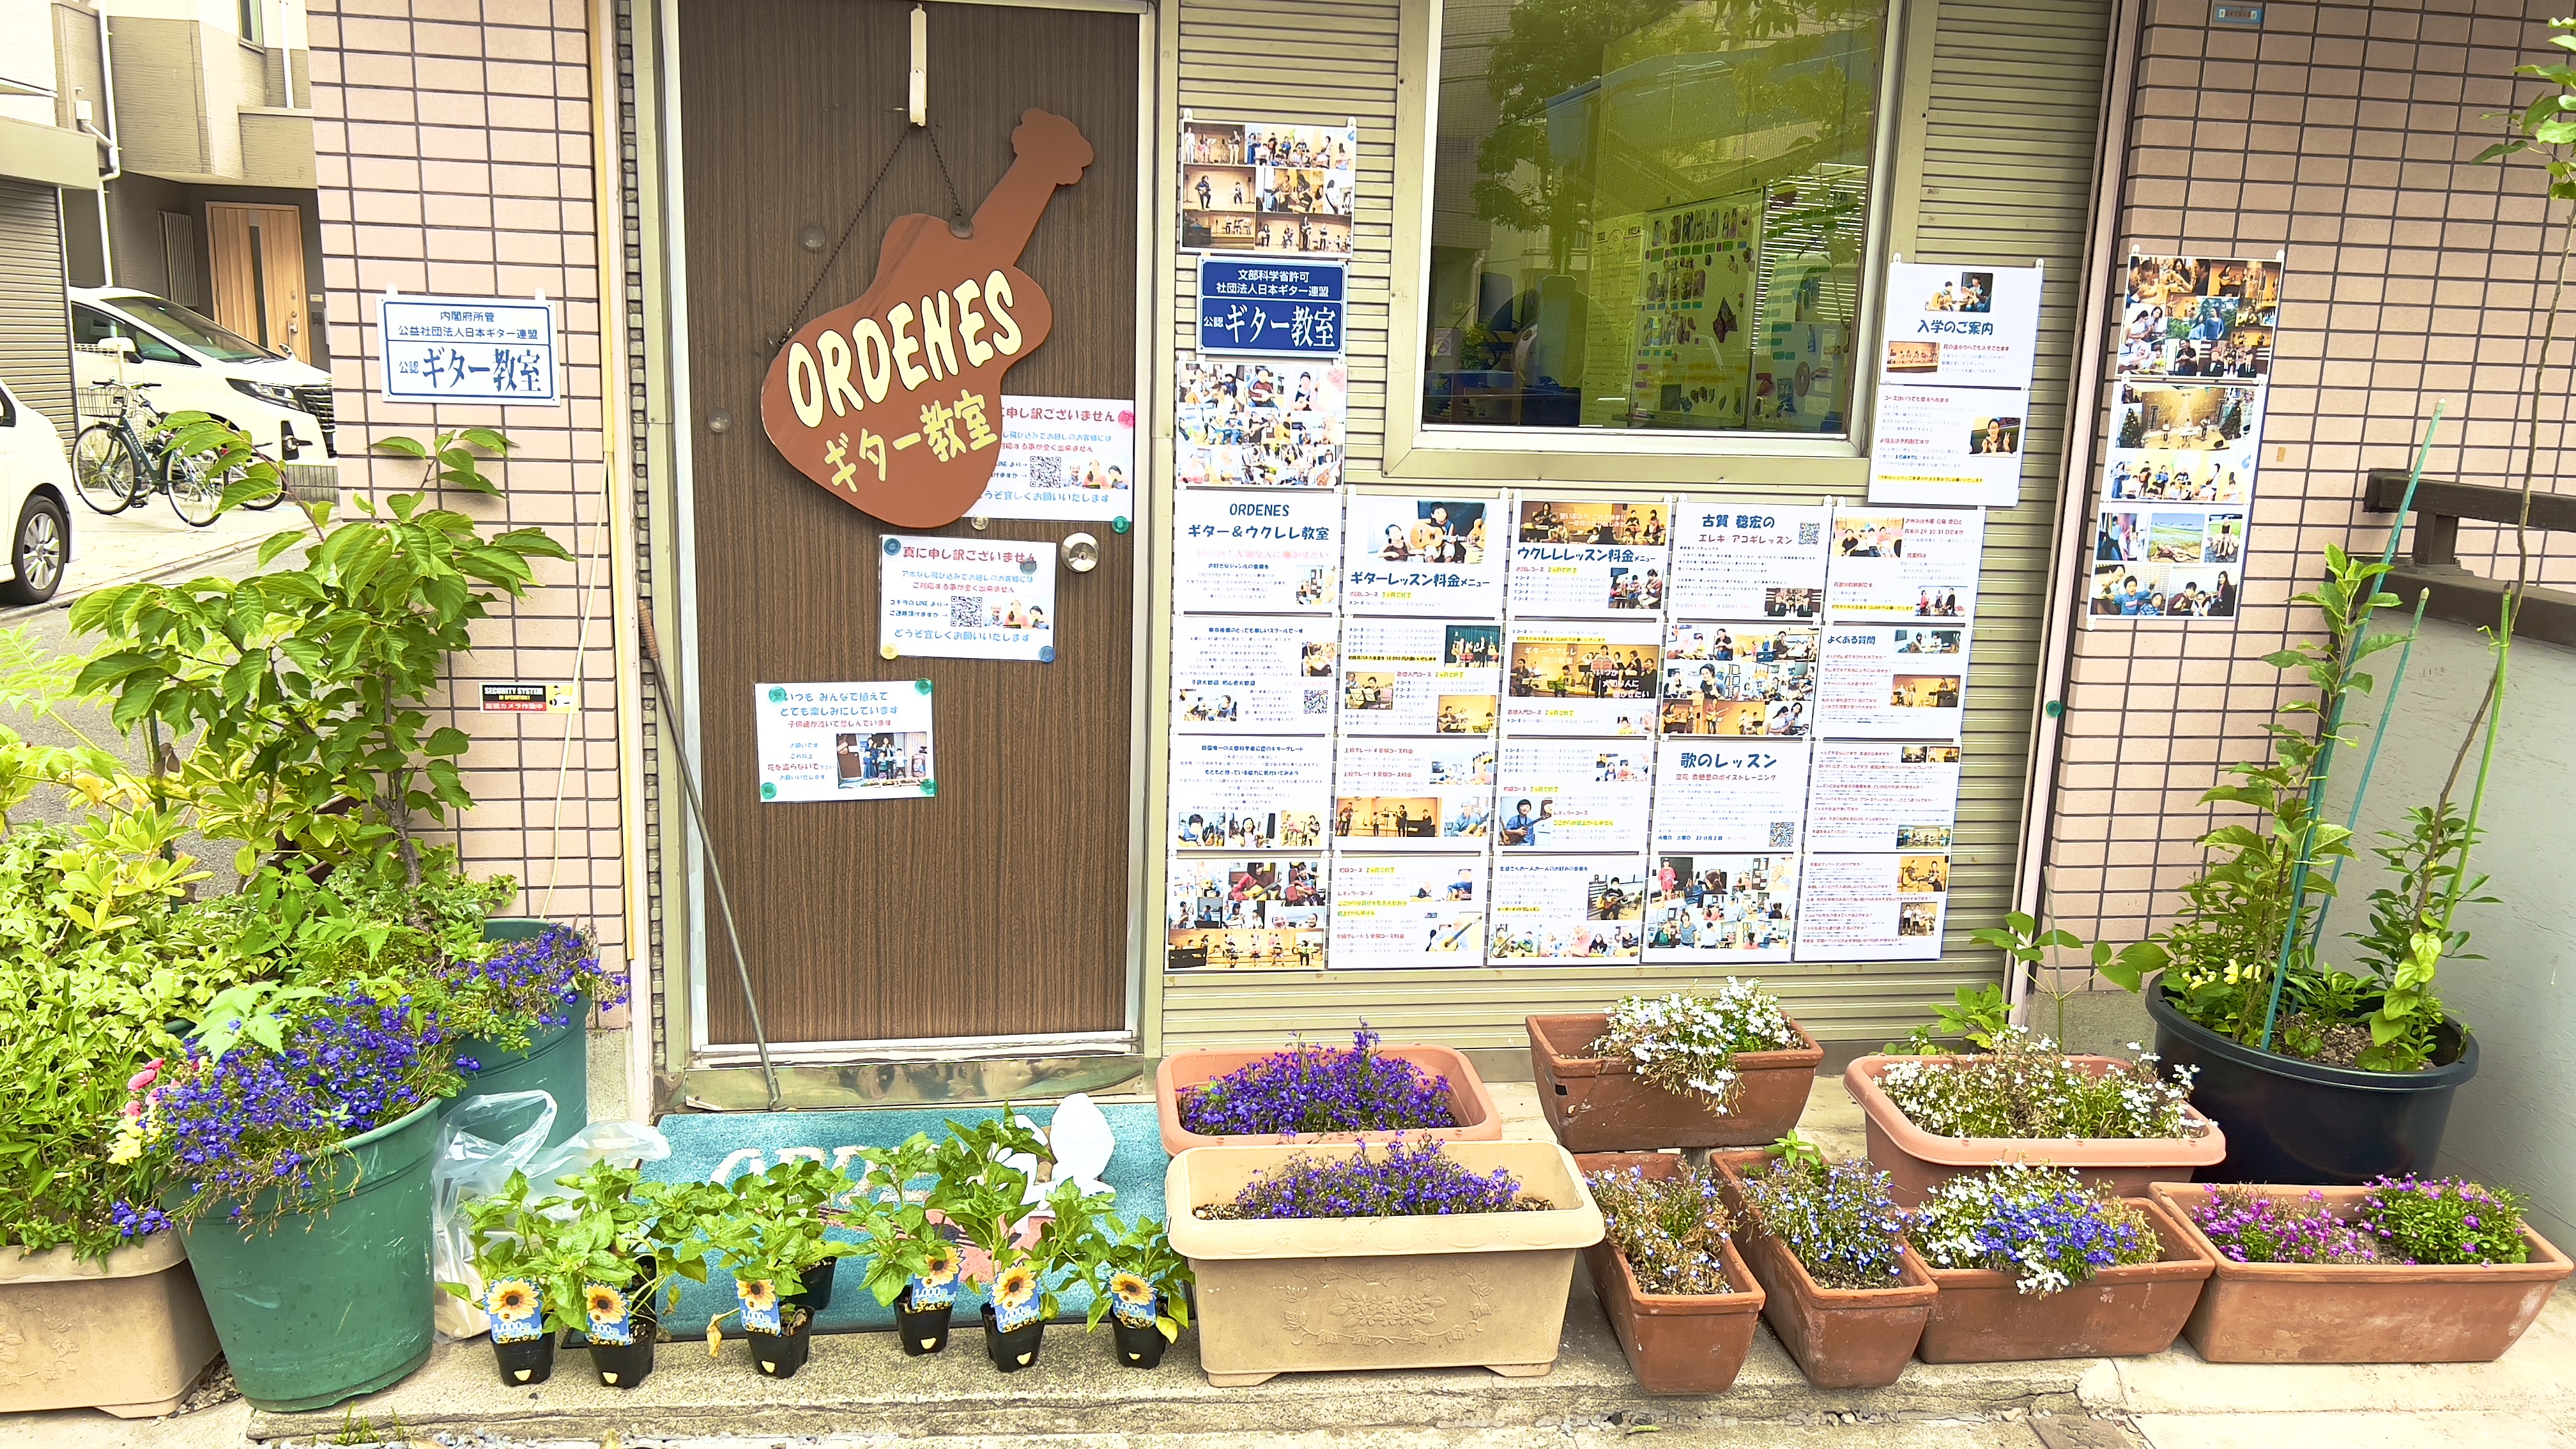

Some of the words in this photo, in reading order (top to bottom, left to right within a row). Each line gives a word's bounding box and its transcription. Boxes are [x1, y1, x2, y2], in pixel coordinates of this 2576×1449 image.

[1238, 269, 1310, 283] 文部科学省許可
[1216, 282, 1329, 297] 社団法人日本ギター連盟
[440, 311, 494, 322] 内閣府所管
[399, 325, 538, 339] 公益社団法人日本ギター連盟
[1204, 316, 1223, 328] 公認
[1225, 303, 1336, 347] ギター教室
[1917, 319, 1993, 335] 入学のご案内
[788, 269, 1023, 428] ORDENES
[399, 361, 418, 373] 公認
[422, 346, 541, 392] ギター教室
[824, 388, 998, 493] ギター教室
[979, 490, 1109, 503] うぞ宜しくお願いいたします
[1229, 503, 1290, 516] ORDENES
[1703, 514, 1729, 527] 古賀
[903, 546, 1036, 564] 真に申し訳ございません
[1517, 547, 1655, 562] ウクレレレッスン料金メニュー
[1351, 572, 1490, 587] ギターレッスン料金メニュー
[894, 629, 1030, 642] どうぞ宜しくお願いいたします
[1828, 636, 1876, 645] よくある質問
[484, 687, 517, 695] SECURITY
[781, 706, 899, 716] とても楽しみにしています
[1680, 752, 1777, 769] 歌のレッスン
